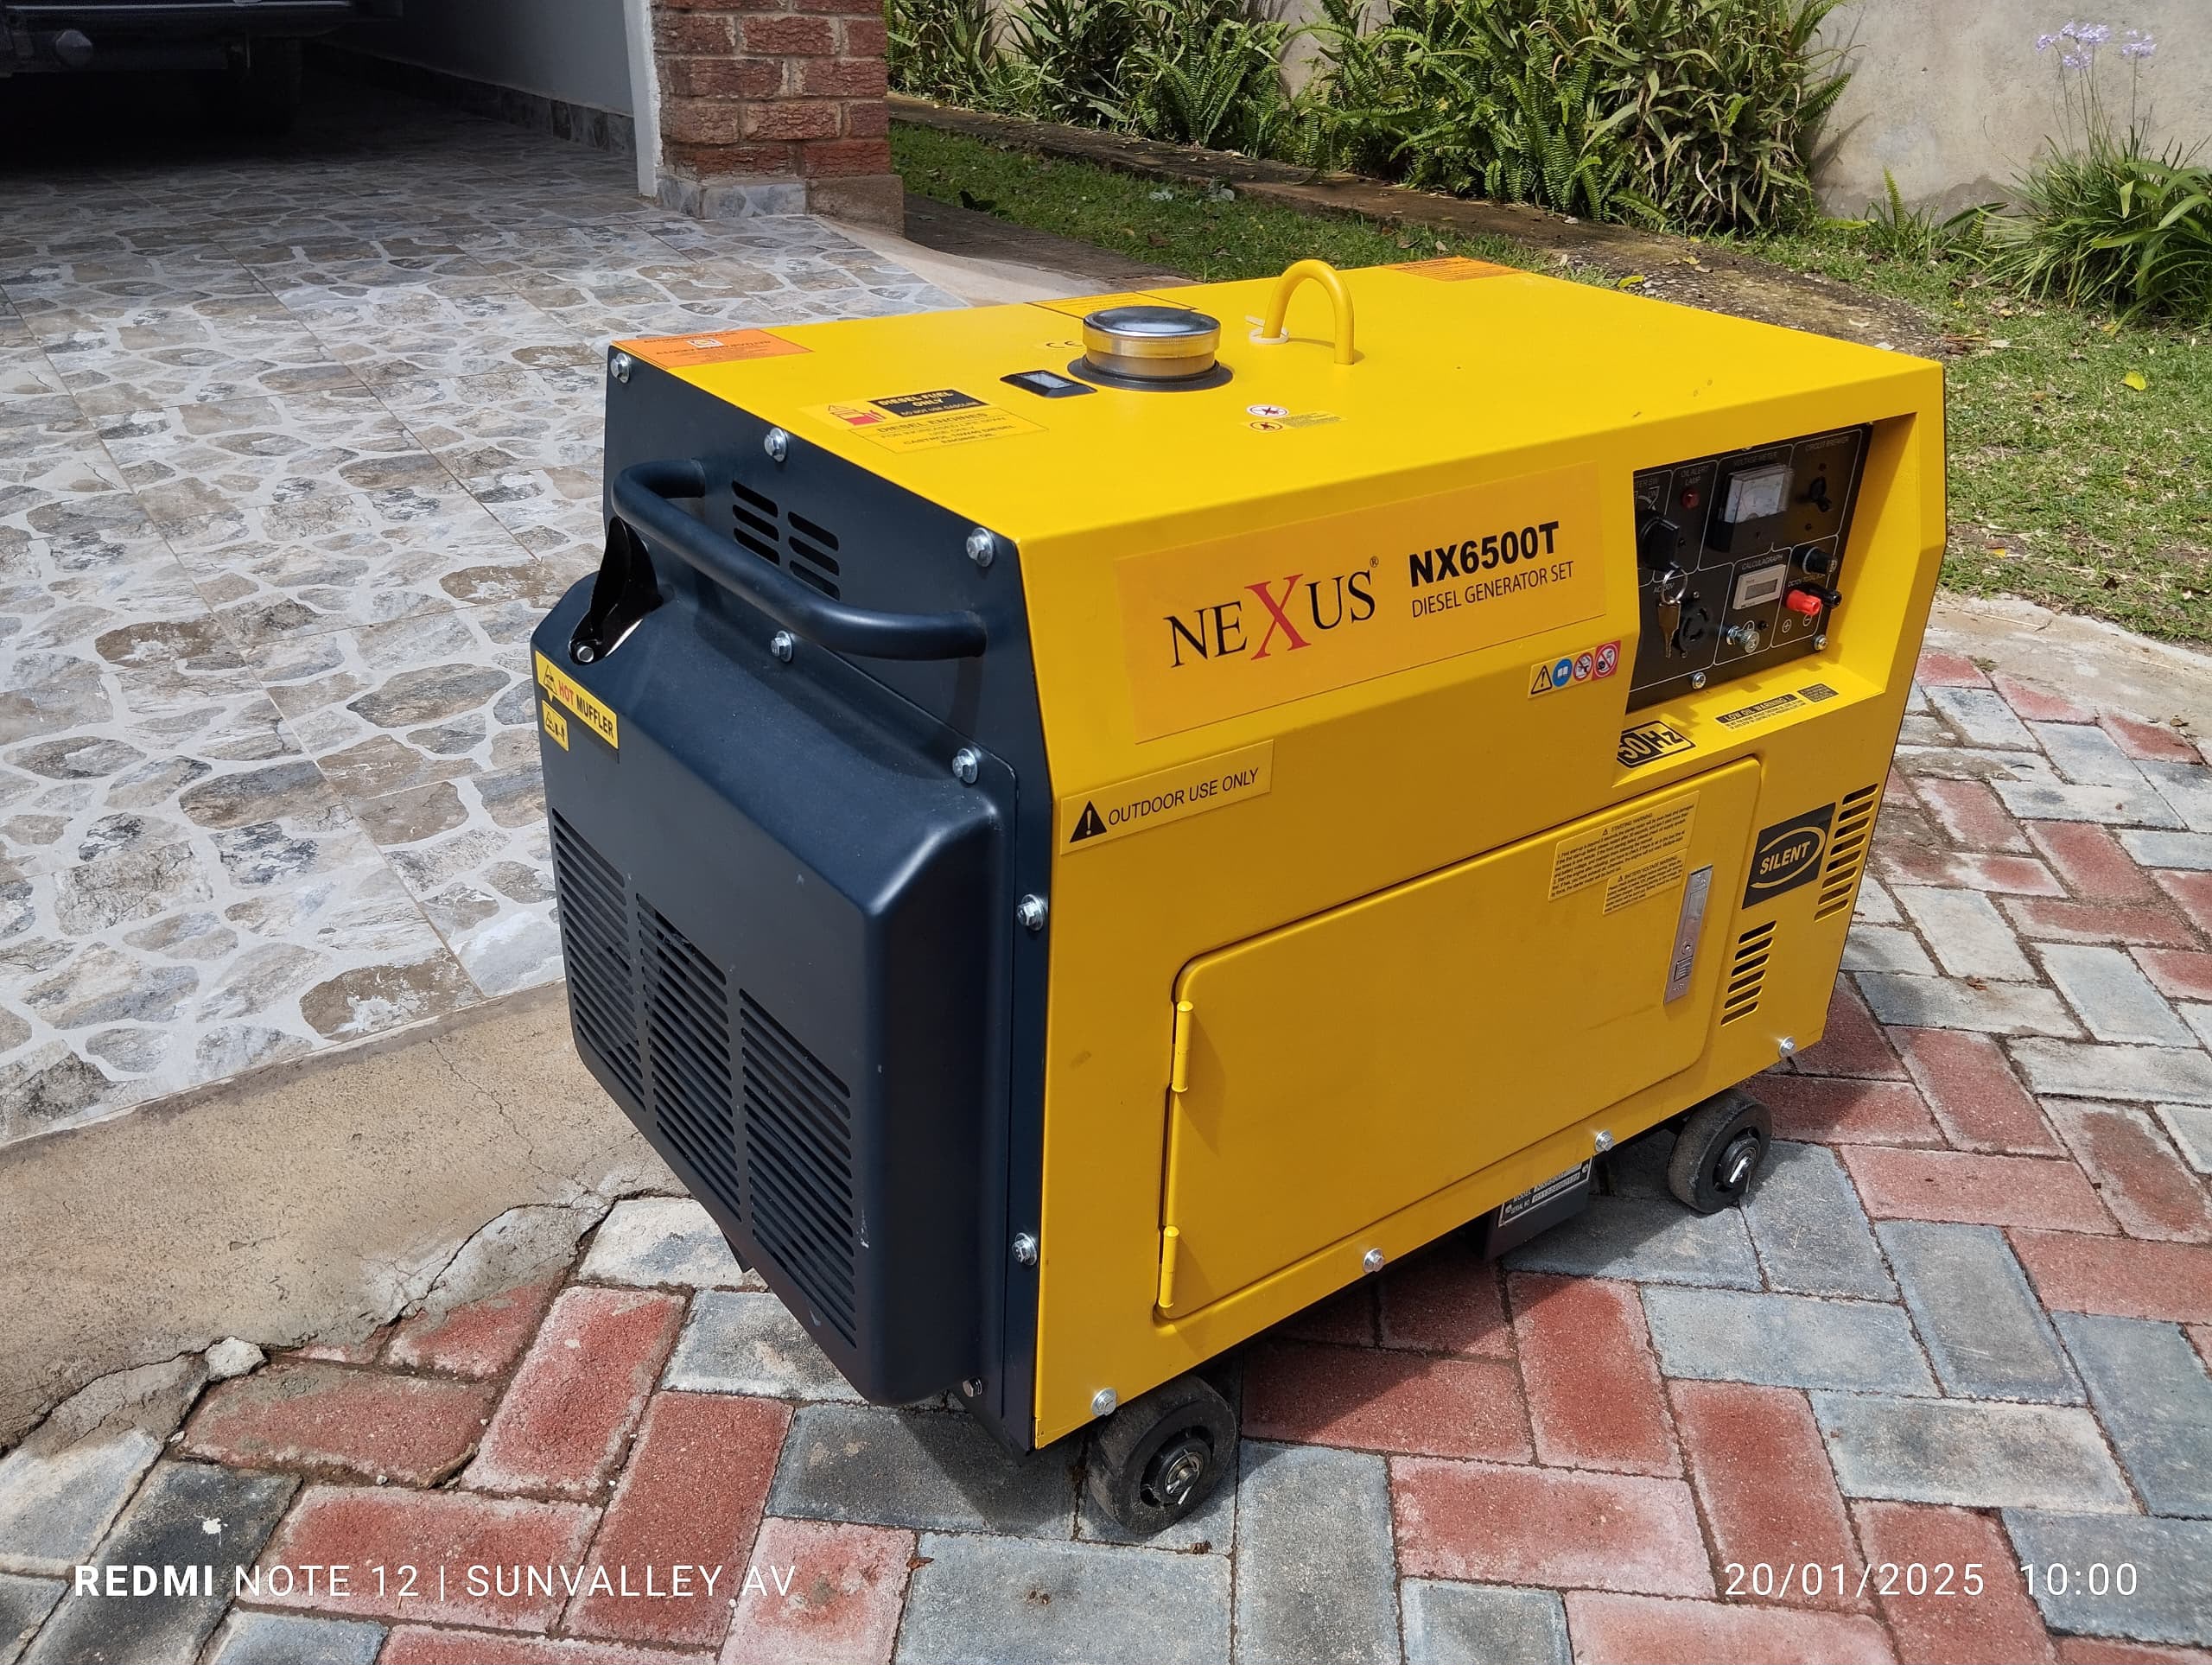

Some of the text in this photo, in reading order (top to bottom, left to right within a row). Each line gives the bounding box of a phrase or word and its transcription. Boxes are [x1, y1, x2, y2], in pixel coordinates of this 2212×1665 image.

[877, 391, 954, 406] DIESEL FUEL
[912, 397, 944, 408] ONLY
[877, 412, 988, 433] DIESEL ENGINES
[1408, 520, 1560, 588] NX6500T
[1412, 560, 1574, 619] DIESEL GENERATOR SET
[1163, 569, 1376, 668] NEXUS
[558, 679, 614, 740] HOT MUFFLER
[1724, 711, 1741, 722] LOW
[1740, 707, 1758, 717] OIL
[1754, 696, 1787, 712] WARNING
[1109, 767, 1259, 825] OUTDOOR USE ONLY
[1759, 841, 1811, 875] SILENT
